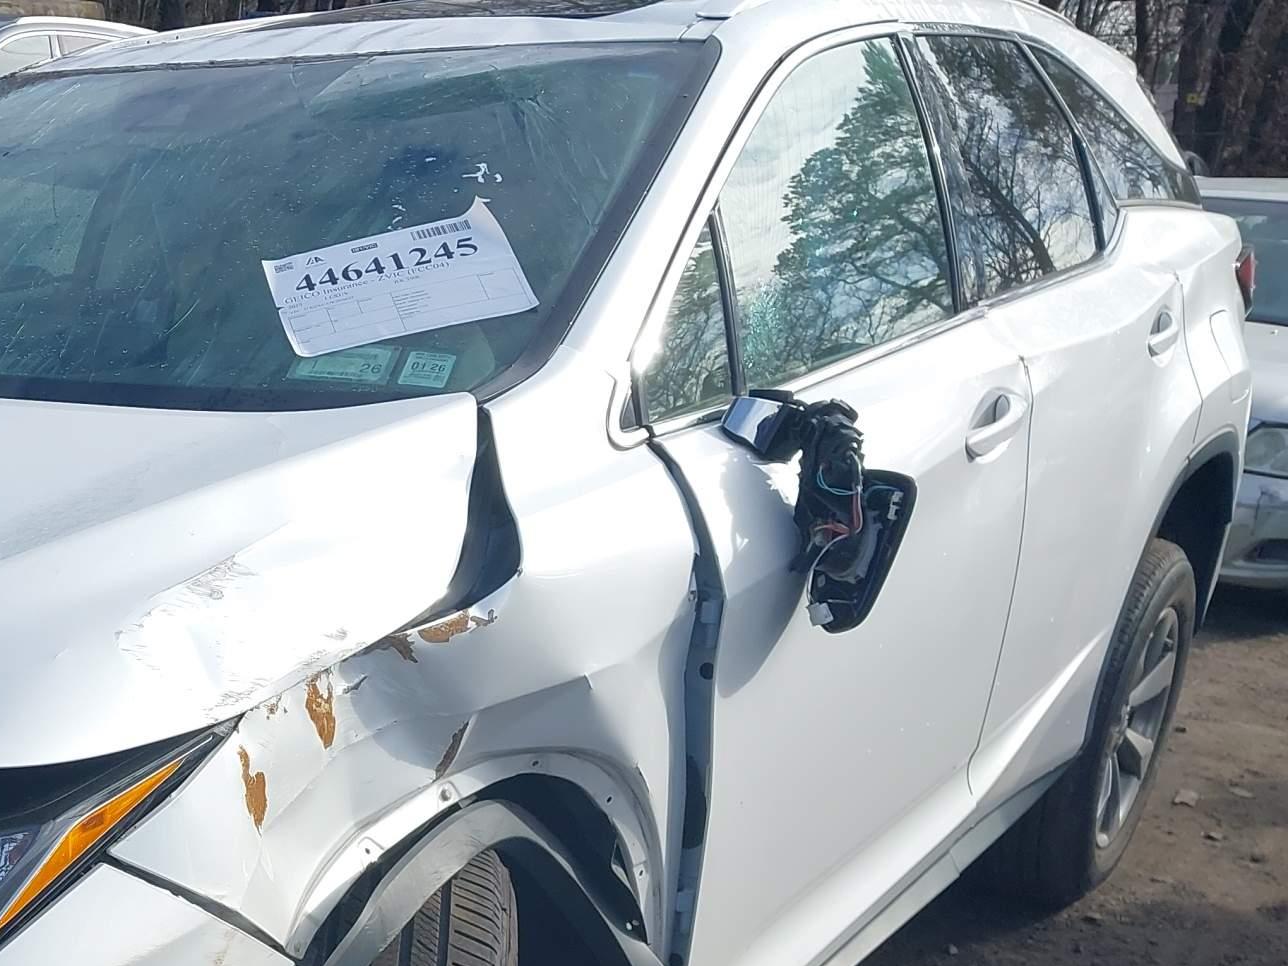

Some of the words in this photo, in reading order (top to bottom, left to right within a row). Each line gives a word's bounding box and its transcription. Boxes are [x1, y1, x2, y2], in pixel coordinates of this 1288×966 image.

[295, 236, 479, 292] 44641245
[284, 291, 320, 304] GEICO
[323, 280, 368, 296] Insurance
[359, 363, 382, 374] 26
